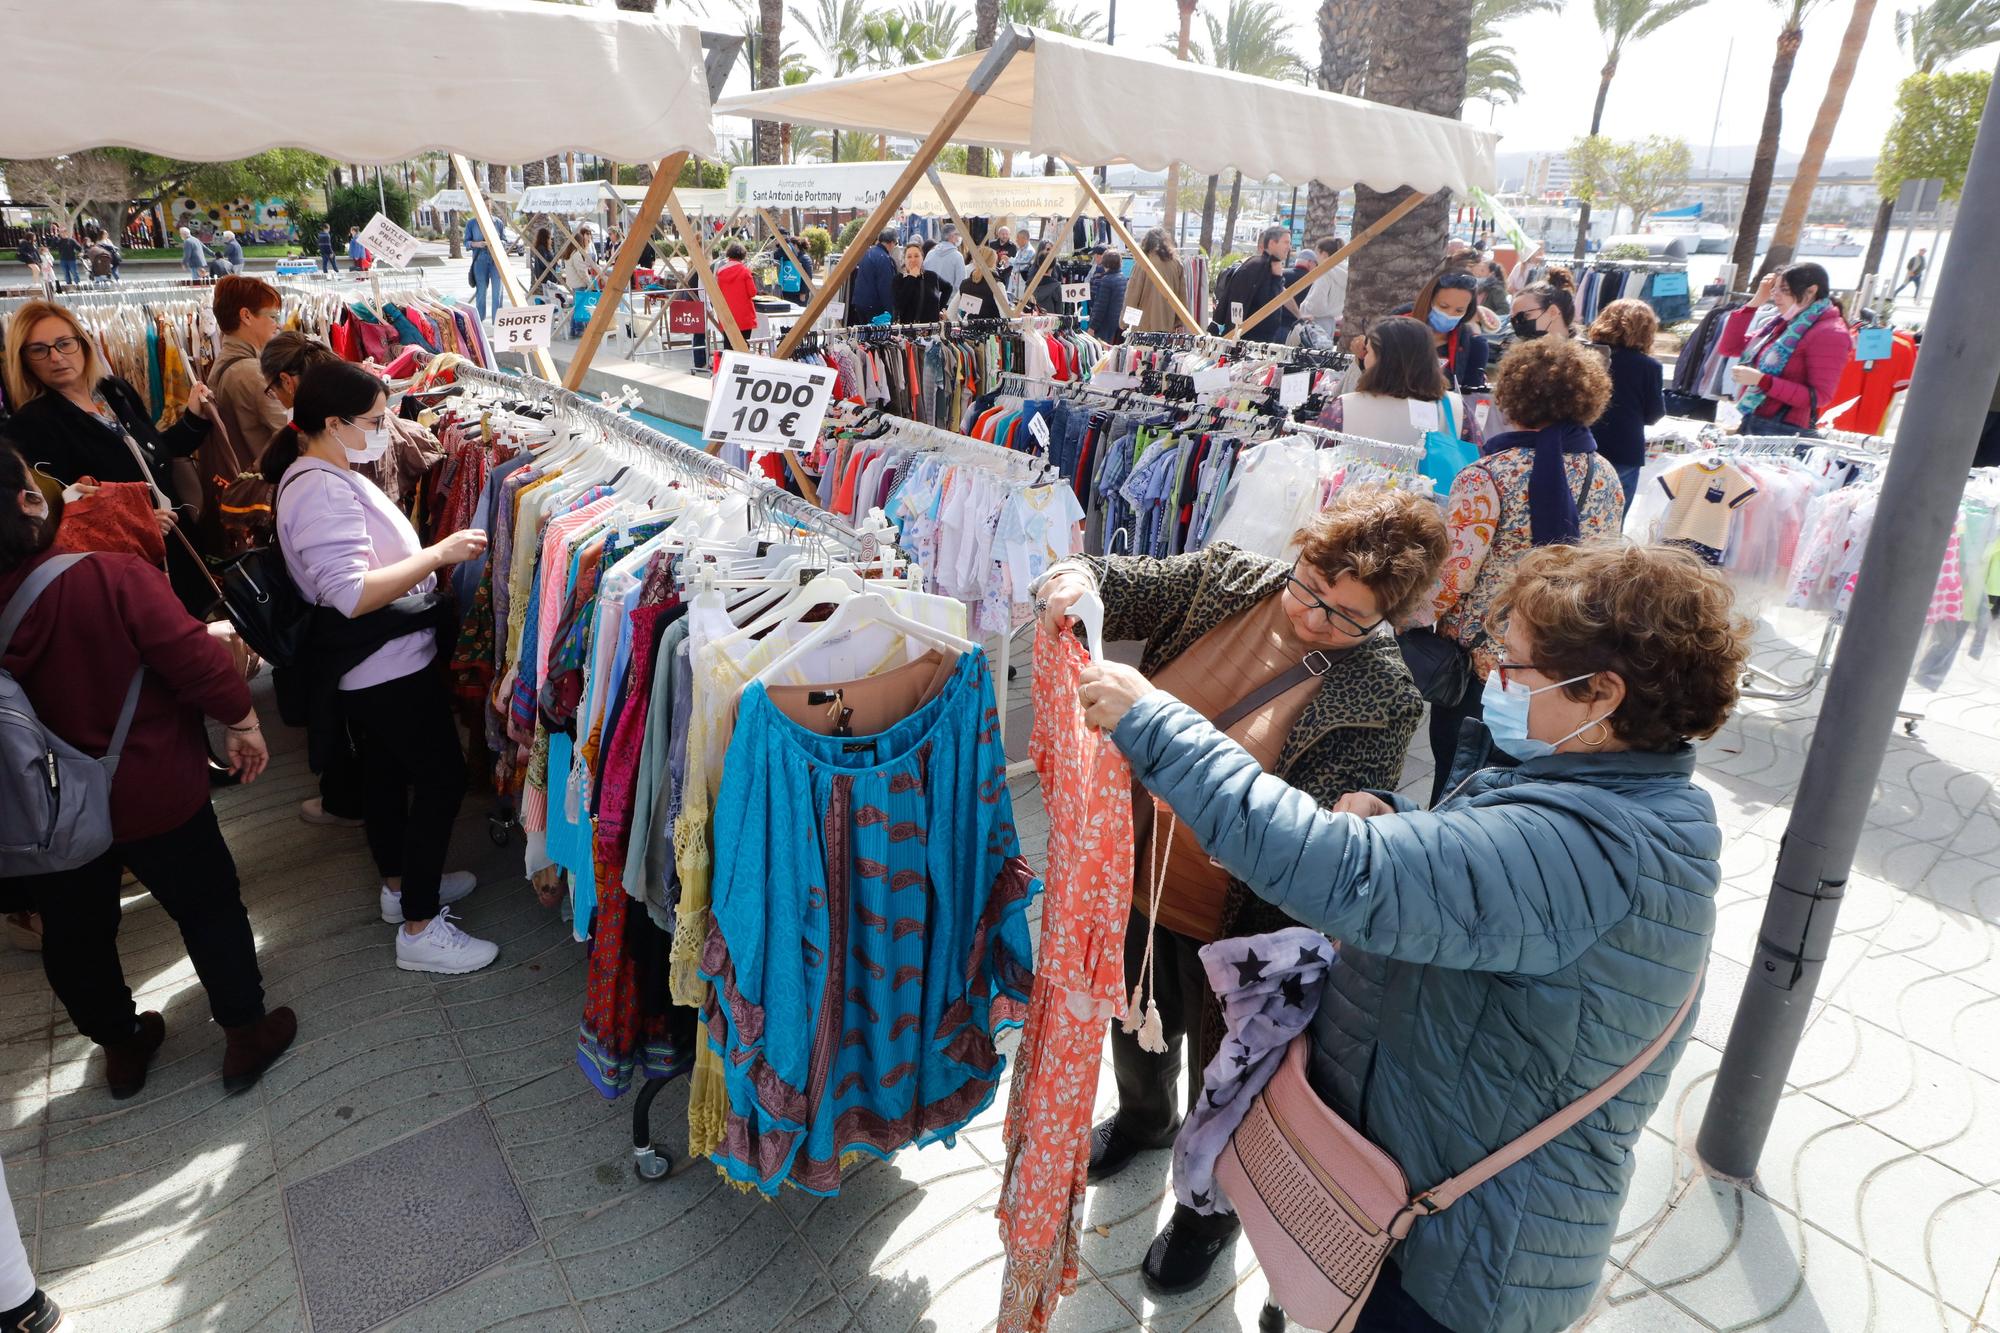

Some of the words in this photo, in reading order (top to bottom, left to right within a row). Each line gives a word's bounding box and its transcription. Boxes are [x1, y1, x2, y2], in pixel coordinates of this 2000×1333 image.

[752, 190, 768, 201] Sant
[769, 190, 793, 201] Antoni
[794, 191, 804, 202] de
[804, 190, 842, 203] Portmany
[379, 230, 401, 248] PRICE
[380, 222, 408, 243] OUTLET
[368, 235, 384, 248] ALL
[386, 246, 396, 255] 10
[1065, 289, 1077, 298] 10
[1079, 288, 1087, 297] €
[498, 314, 547, 327] SHORTS
[509, 330, 518, 343] 5
[523, 329, 532, 341] €
[735, 376, 814, 408] TODO
[731, 406, 769, 433] 10
[778, 412, 801, 437] €
